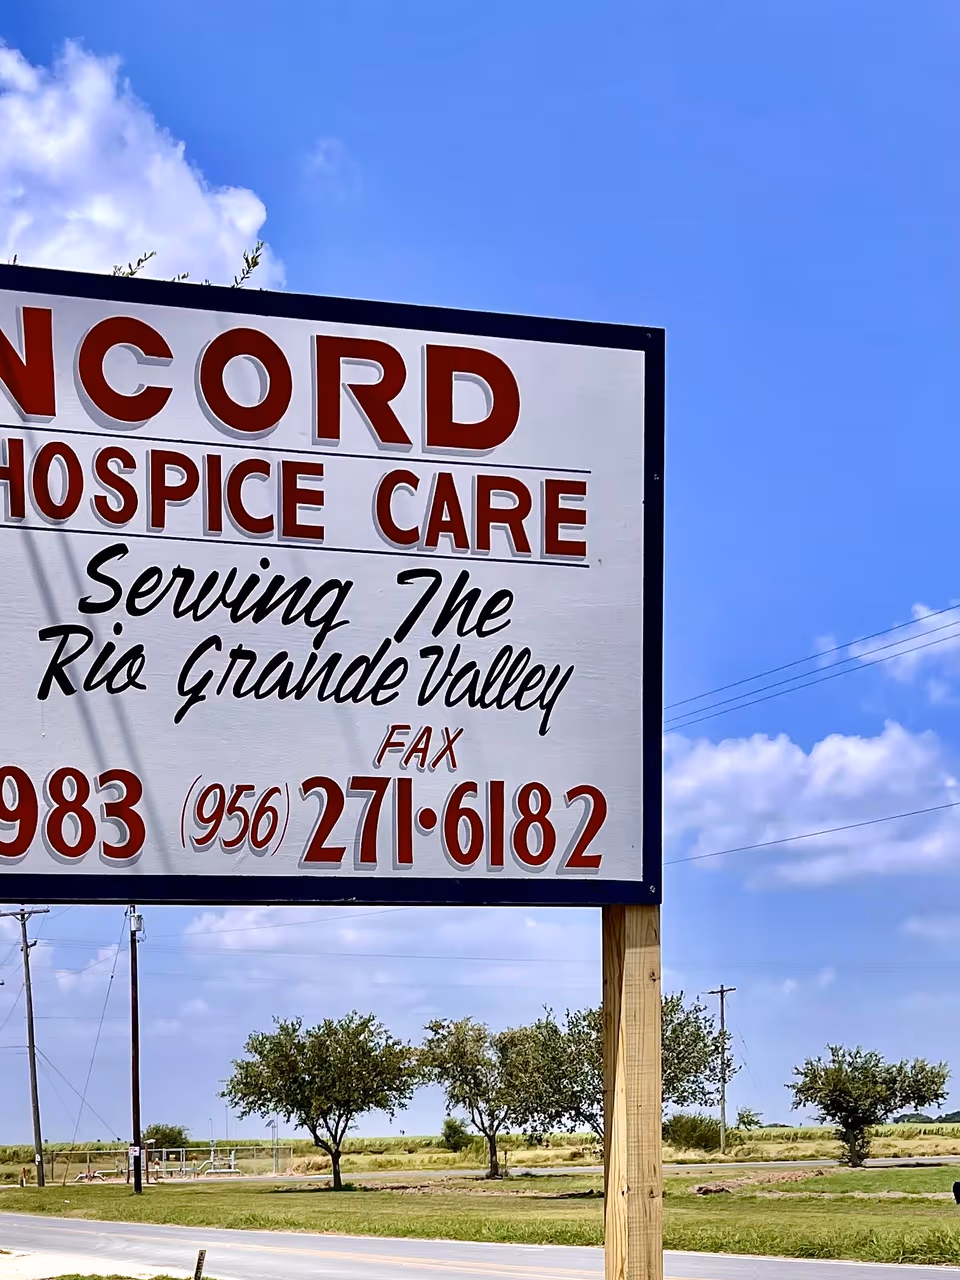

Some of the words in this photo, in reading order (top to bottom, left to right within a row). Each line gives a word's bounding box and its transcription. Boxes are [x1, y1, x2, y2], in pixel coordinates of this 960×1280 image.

[376, 468, 588, 558] CARE
[77, 542, 354, 651] Serving
[393, 567, 514, 645] The
[37, 622, 148, 703] Rio
[174, 635, 409, 726] Grande
[417, 643, 576, 738] Valley
[374, 723, 465, 770] FAX
[180, 774, 291, 858] (956)
